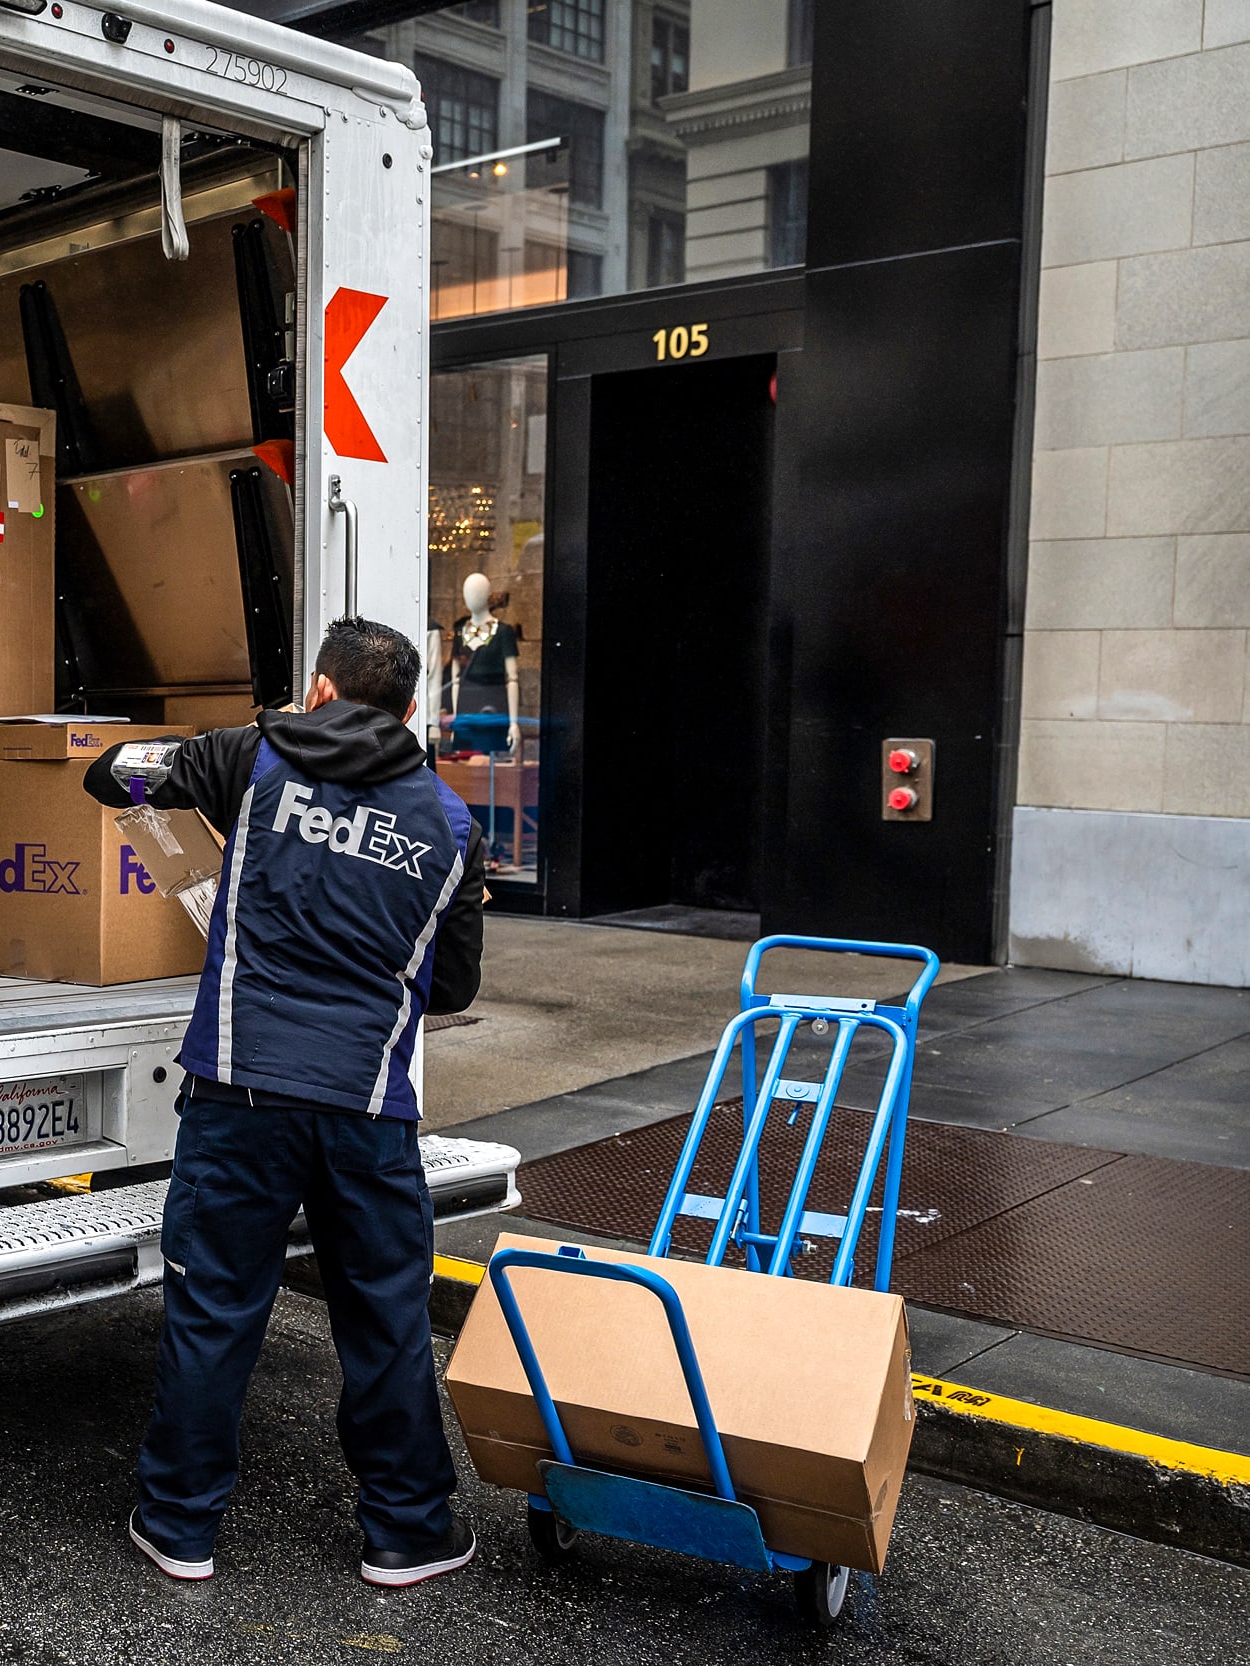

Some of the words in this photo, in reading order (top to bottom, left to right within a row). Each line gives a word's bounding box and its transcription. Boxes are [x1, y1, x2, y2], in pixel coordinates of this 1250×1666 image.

[206, 46, 288, 96] 275902
[652, 323, 709, 361] 105
[25, 462, 42, 481] 7
[70, 733, 101, 748] FedEx
[271, 780, 433, 880] FedEx
